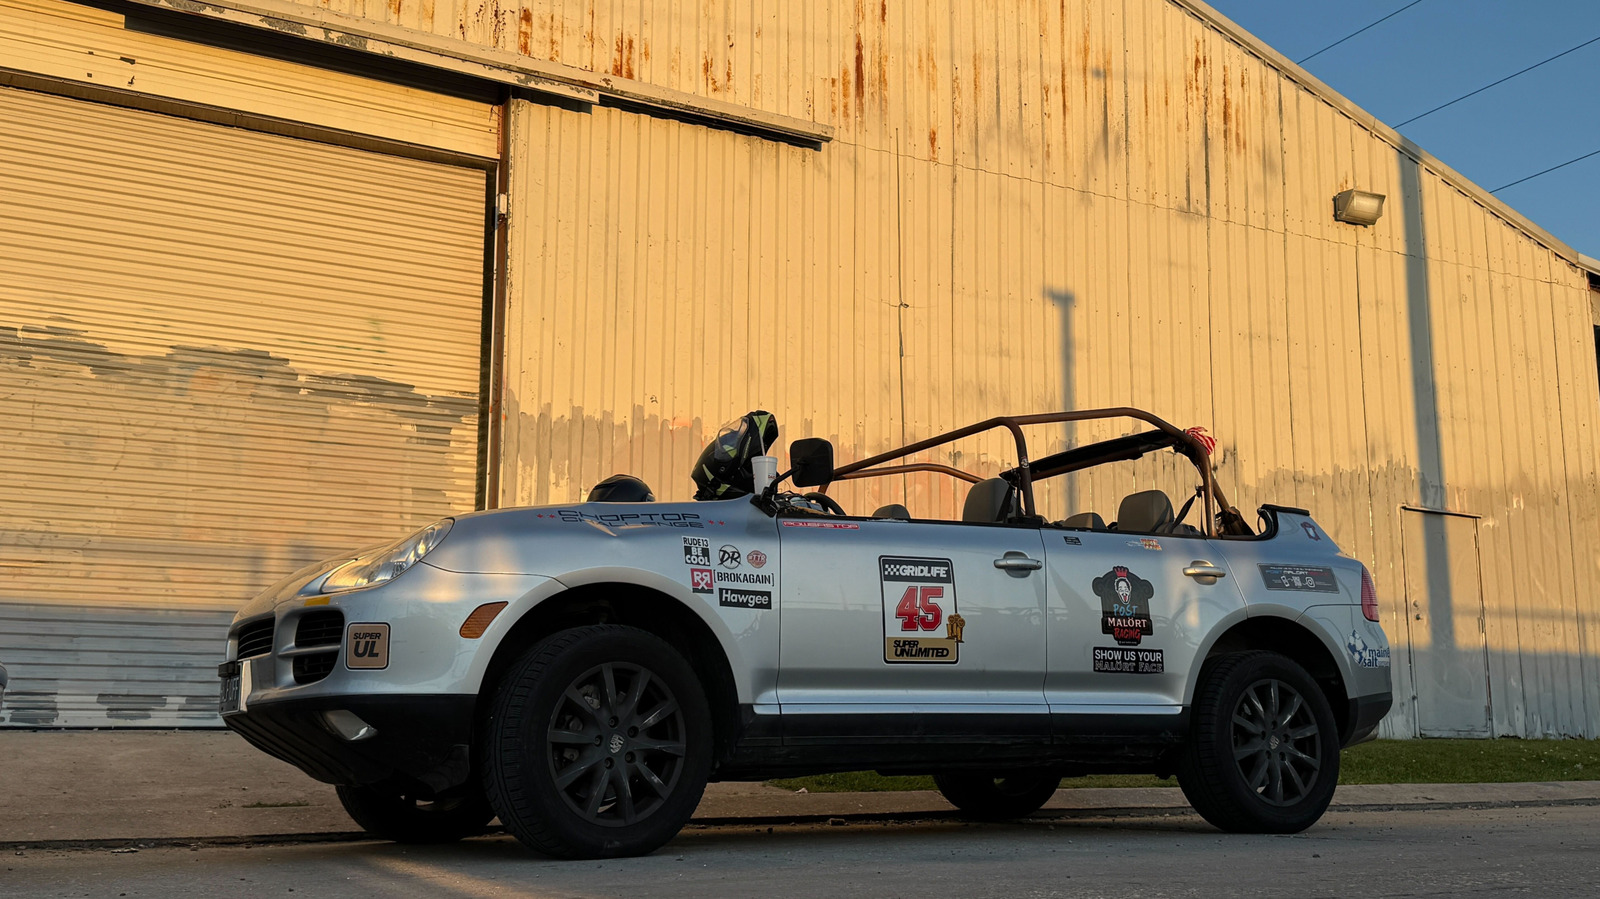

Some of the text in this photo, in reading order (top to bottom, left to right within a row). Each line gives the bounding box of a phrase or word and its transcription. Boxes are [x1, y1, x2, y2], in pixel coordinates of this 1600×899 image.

[558, 510, 700, 522] CHOPTOP
[683, 536, 709, 547] RUDE13
[691, 546, 703, 556] BE
[685, 555, 710, 566] COOL
[899, 565, 949, 577] GRIDLIFE
[722, 589, 769, 607] Hawgee
[895, 586, 944, 631] 45
[1113, 603, 1138, 616] POST
[1108, 617, 1148, 628] MALÖRT
[353, 632, 382, 640] SUPER
[1114, 628, 1141, 639] RACING
[353, 640, 380, 658] UL
[893, 640, 920, 648] SUPER
[894, 647, 949, 658] UNLIMITED
[1095, 649, 1162, 662] SHOW US YOUR
[1363, 656, 1379, 667] salt
[1138, 662, 1163, 673] FACE
